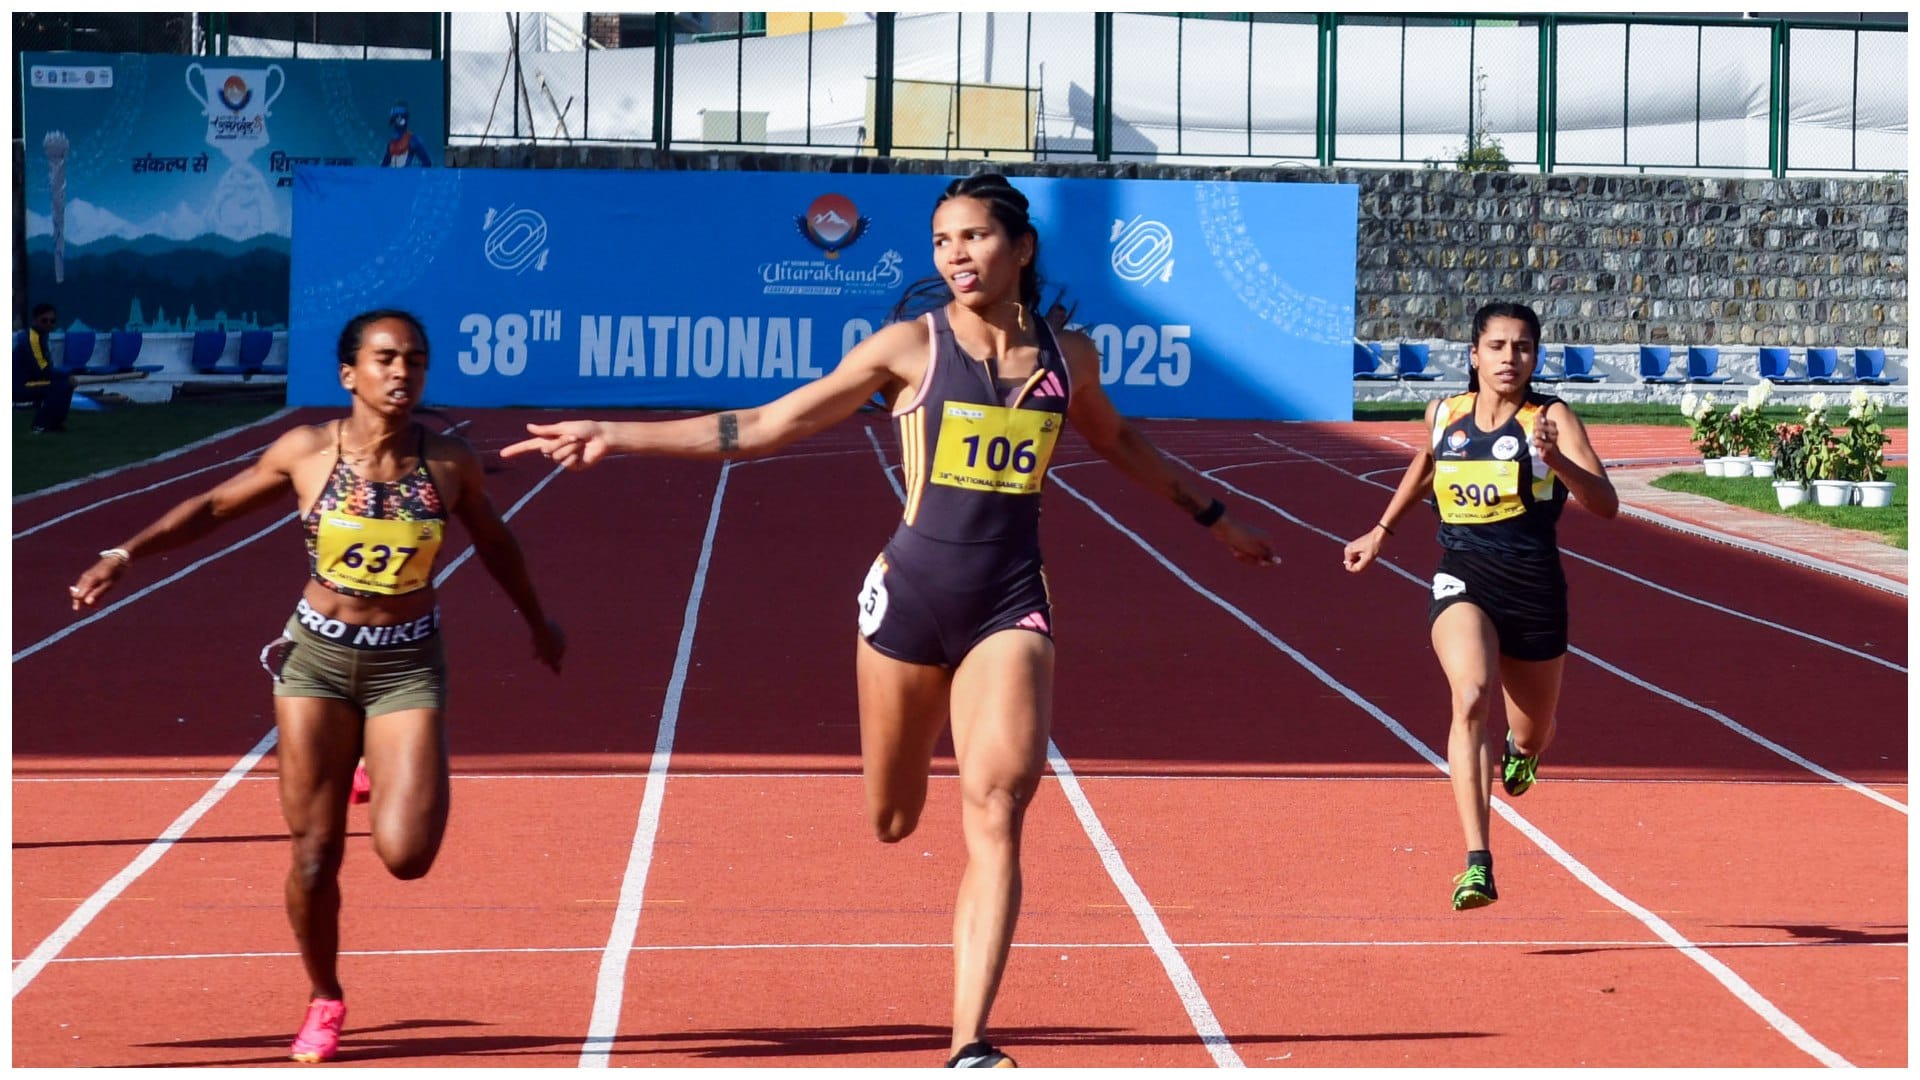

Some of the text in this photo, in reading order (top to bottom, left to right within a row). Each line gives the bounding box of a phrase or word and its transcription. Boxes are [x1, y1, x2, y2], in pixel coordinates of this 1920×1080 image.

[132, 152, 189, 173] संकल्प
[192, 152, 209, 173] से
[758, 261, 877, 284] Uttarakhand
[458, 309, 562, 377] 38TH
[578, 315, 823, 379] NATIONAL
[1063, 322, 1192, 387] 025
[962, 434, 1036, 474] 106
[954, 474, 993, 487] NATIONAL
[1449, 483, 1500, 507] 390
[343, 543, 419, 576] 637
[864, 586, 879, 617] 5
[296, 598, 347, 639] PRO
[352, 614, 431, 646] NIKE
